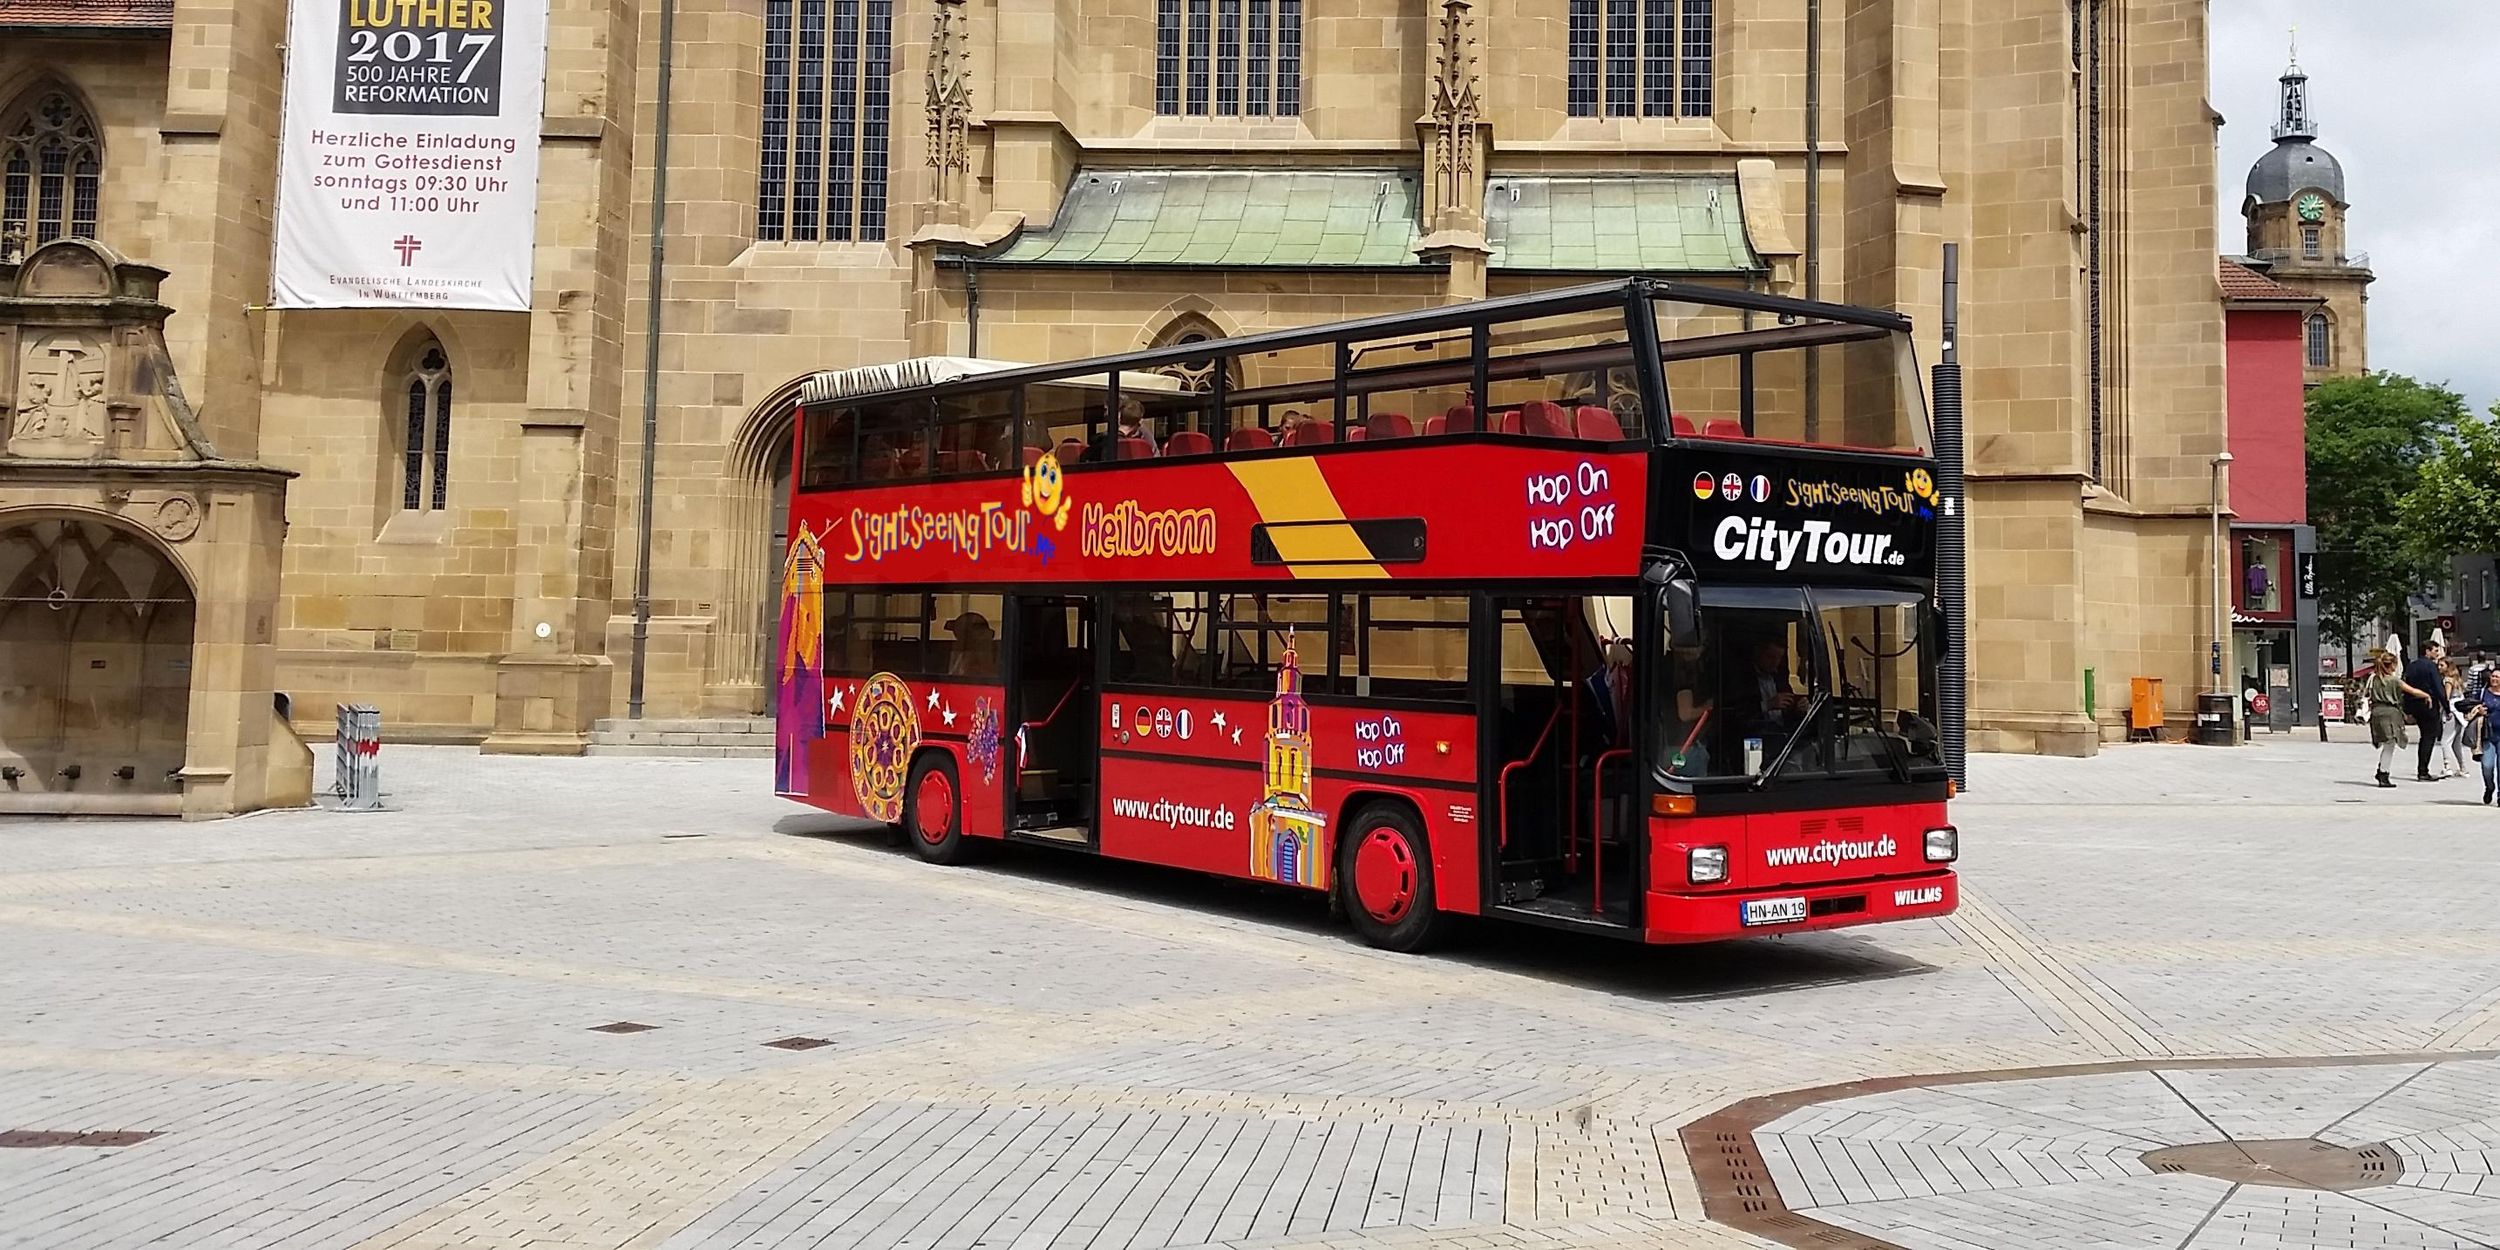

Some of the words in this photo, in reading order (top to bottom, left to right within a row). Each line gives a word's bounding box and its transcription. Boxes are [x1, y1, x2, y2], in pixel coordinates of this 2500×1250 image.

[350, 0, 493, 29] LUTHER
[347, 30, 496, 84] 2017
[346, 65, 383, 83] 500
[387, 66, 451, 84] JAHRE
[345, 85, 489, 104] REFORMATION
[311, 130, 408, 148] Herzliche
[416, 133, 516, 153] Einladung
[323, 155, 365, 169] zum
[374, 153, 502, 171] Gottesdienst
[313, 174, 408, 194] sonntags
[415, 176, 467, 192] 09:30
[475, 177, 508, 193] Uhr
[341, 196, 380, 211] und
[391, 197, 439, 213] 11:00
[447, 197, 480, 214] Uhr
[1527, 475, 1571, 505] Hop
[1577, 462, 1609, 496] On
[1082, 500, 1216, 559] Heilbronn
[1530, 518, 1574, 550] Hop
[1580, 503, 1616, 541] Off
[1713, 515, 1905, 571] CityTour.de
[1355, 721, 1380, 742] Hop
[1383, 716, 1401, 738] On
[1357, 748, 1382, 769] Hop
[1385, 743, 1405, 765] Off
[1112, 796, 1235, 831] www.citytour.de
[1766, 834, 1897, 867] www.citytour.de
[1894, 886, 1943, 907] WILLMS
[1750, 904, 1788, 919] HN-AN
[1791, 902, 1805, 916] 19
